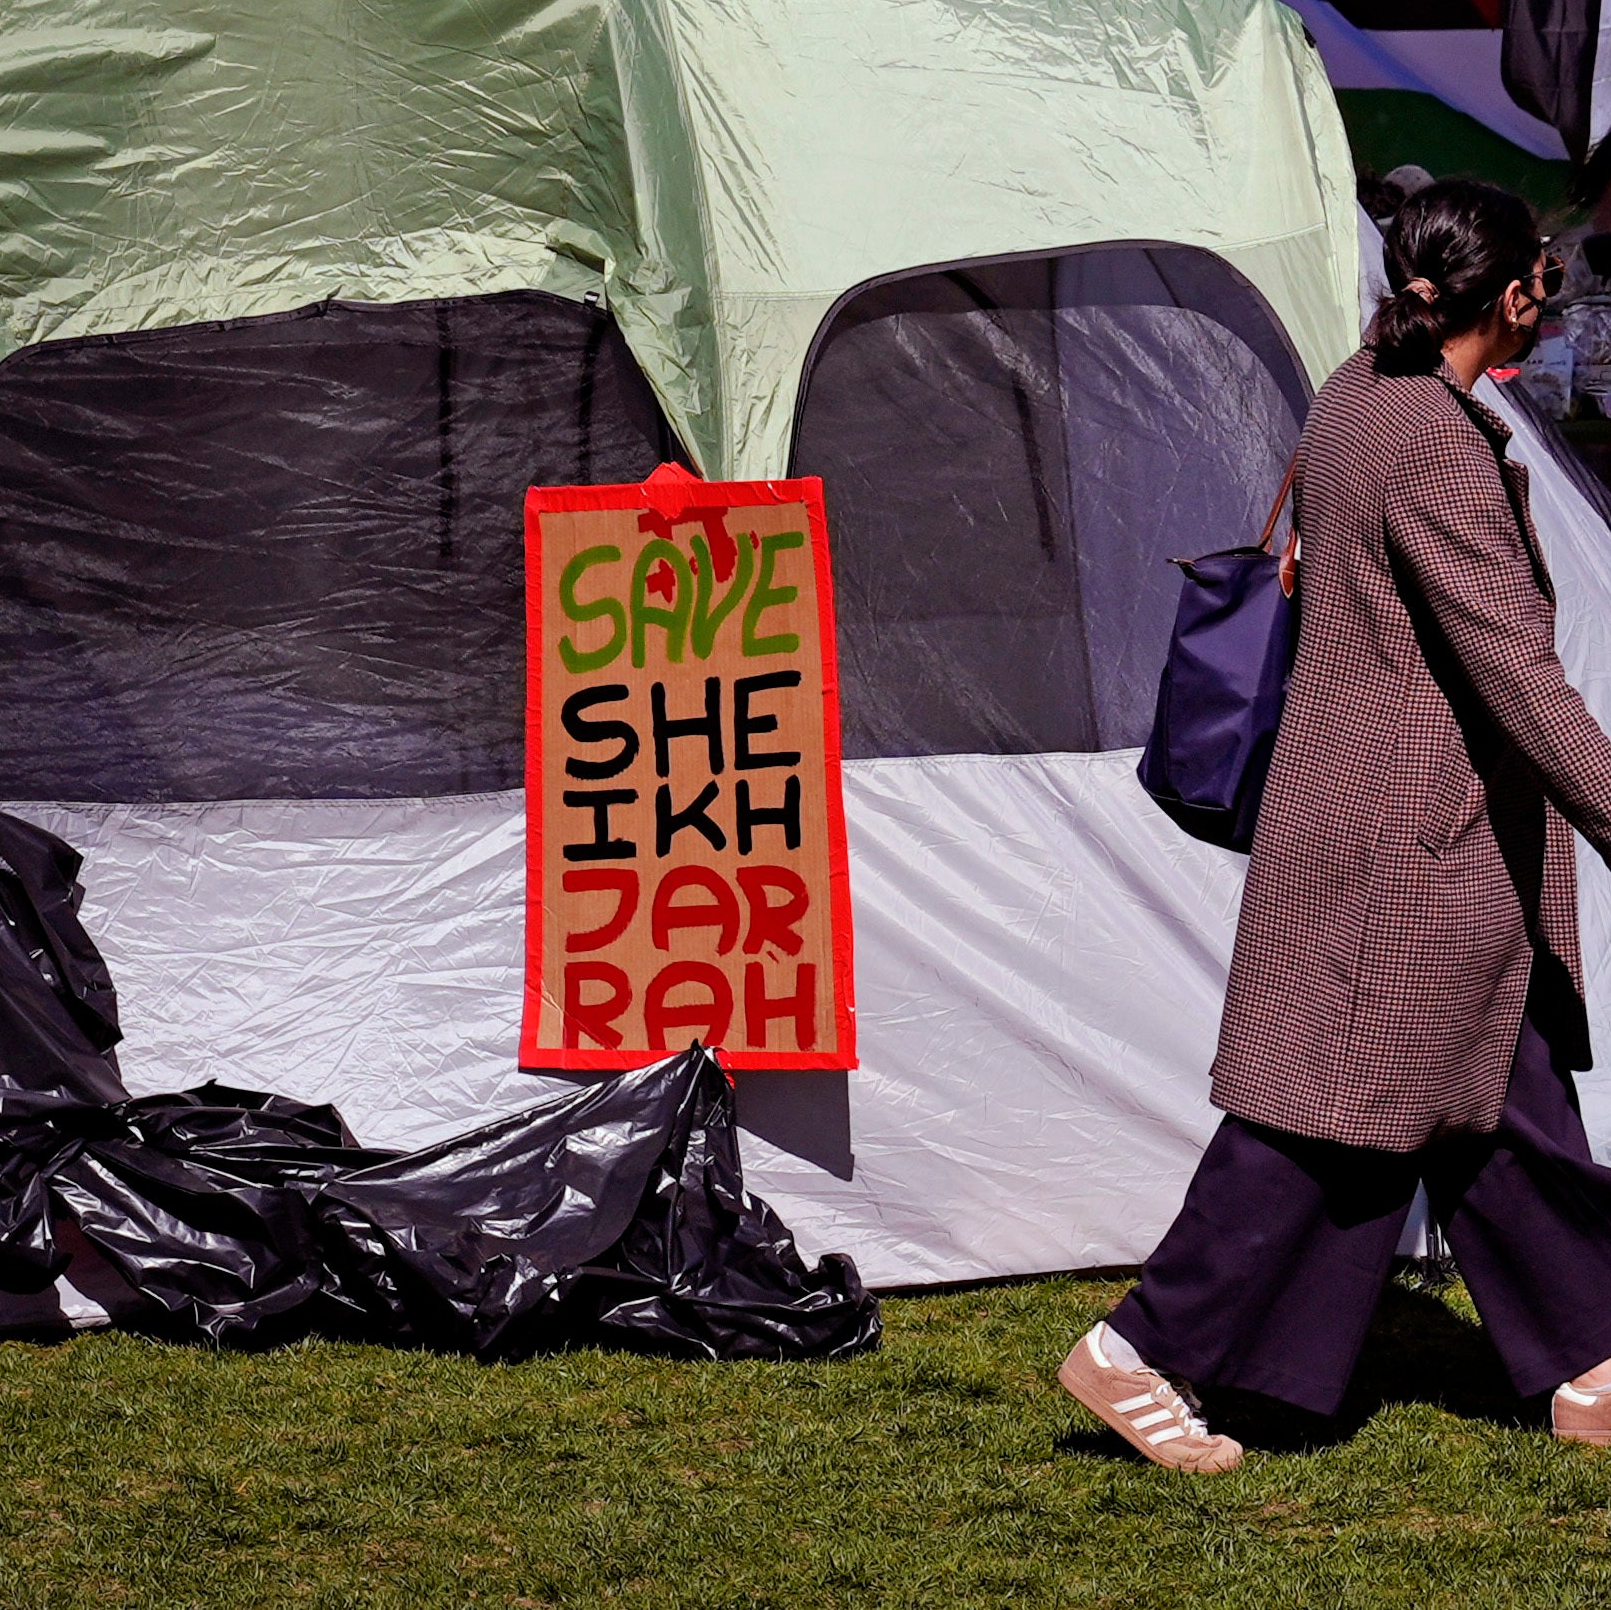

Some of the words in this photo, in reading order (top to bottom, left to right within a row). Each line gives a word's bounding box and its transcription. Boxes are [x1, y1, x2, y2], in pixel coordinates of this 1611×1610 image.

[558, 531, 804, 673] SAVE
[561, 670, 802, 780] SHE
[563, 774, 802, 862] IKH
[563, 865, 810, 957] JAR
[564, 961, 816, 1050] RAH
